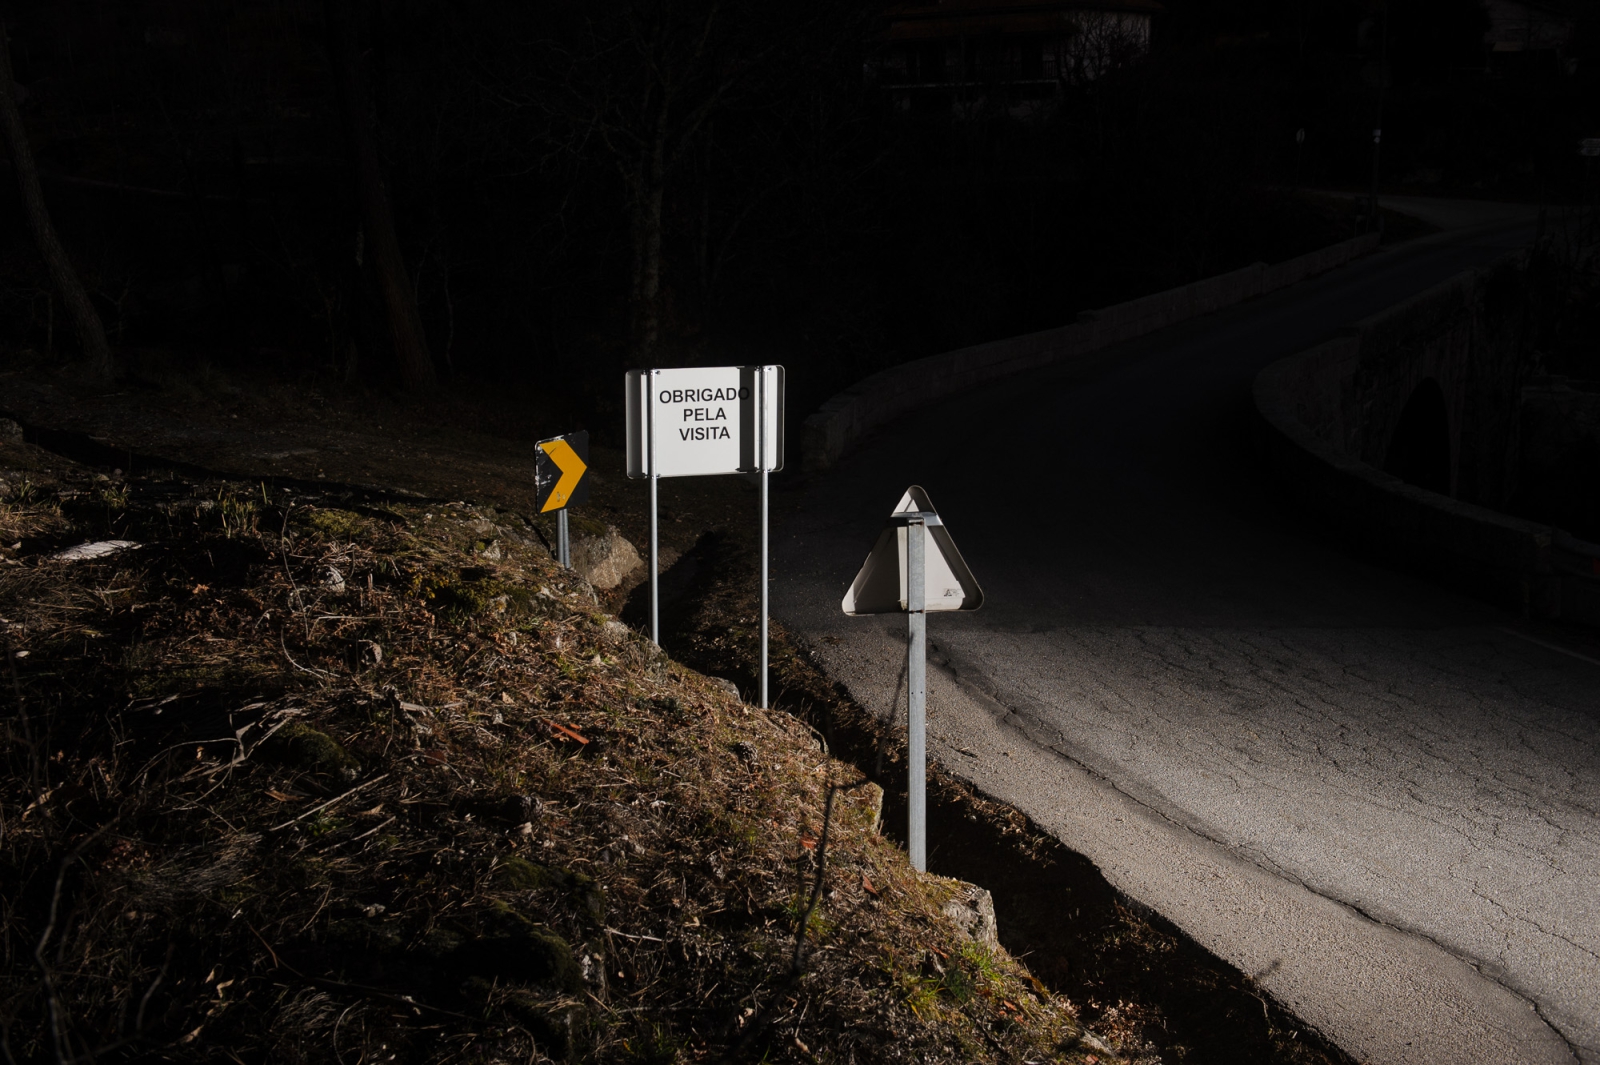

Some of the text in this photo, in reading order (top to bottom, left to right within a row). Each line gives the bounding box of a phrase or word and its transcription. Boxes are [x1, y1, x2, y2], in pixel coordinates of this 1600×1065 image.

[659, 386, 750, 404] OBRIGADO
[683, 407, 727, 422] PELA
[679, 426, 731, 441] VISITA
